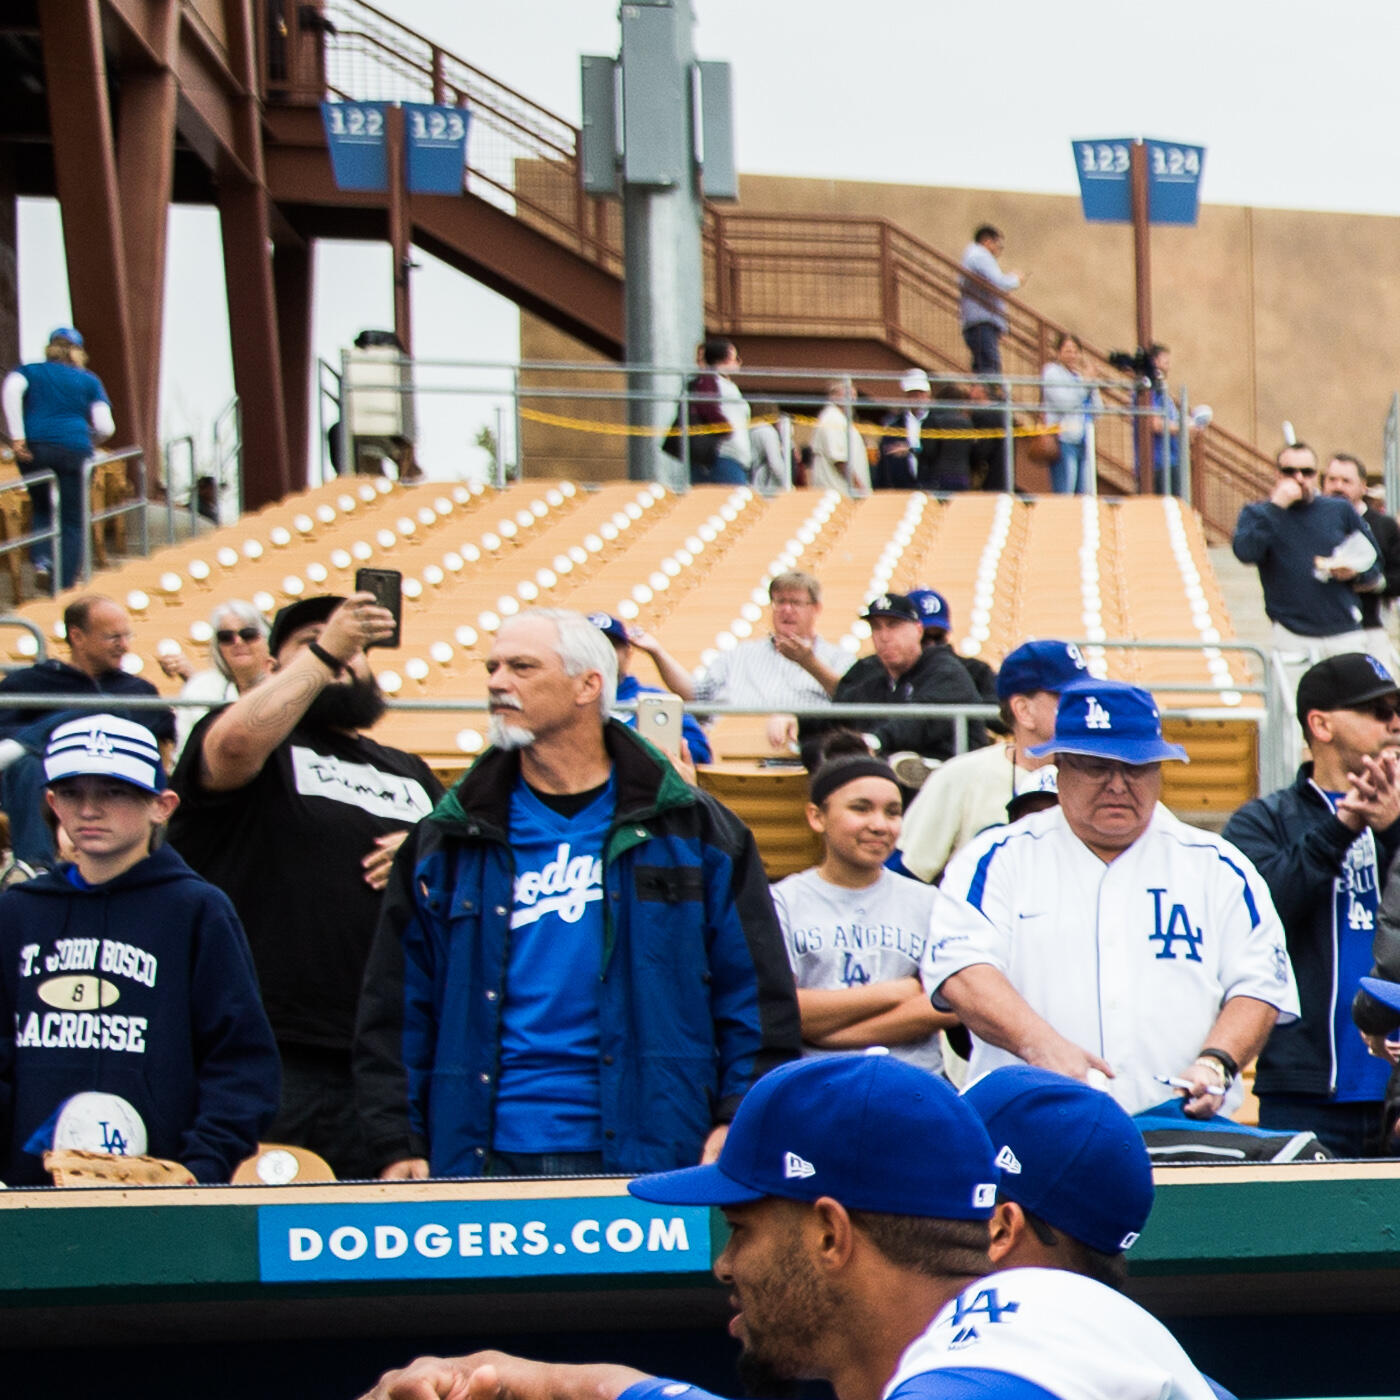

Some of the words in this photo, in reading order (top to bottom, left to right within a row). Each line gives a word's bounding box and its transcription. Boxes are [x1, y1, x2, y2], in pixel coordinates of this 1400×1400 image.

[329, 105, 384, 136] 122
[411, 110, 465, 141] 123
[1081, 143, 1130, 173] 123
[1152, 146, 1200, 175] 124
[1084, 696, 1111, 730] LA
[1147, 888, 1203, 963] LA
[1348, 891, 1374, 930] LA
[789, 927, 823, 956] OS
[834, 923, 927, 962] ANGELE
[45, 938, 100, 972] JOHN
[101, 938, 158, 988] BOSCO
[100, 1121, 128, 1156] LA
[288, 1217, 690, 1262] DODGERS.COM
